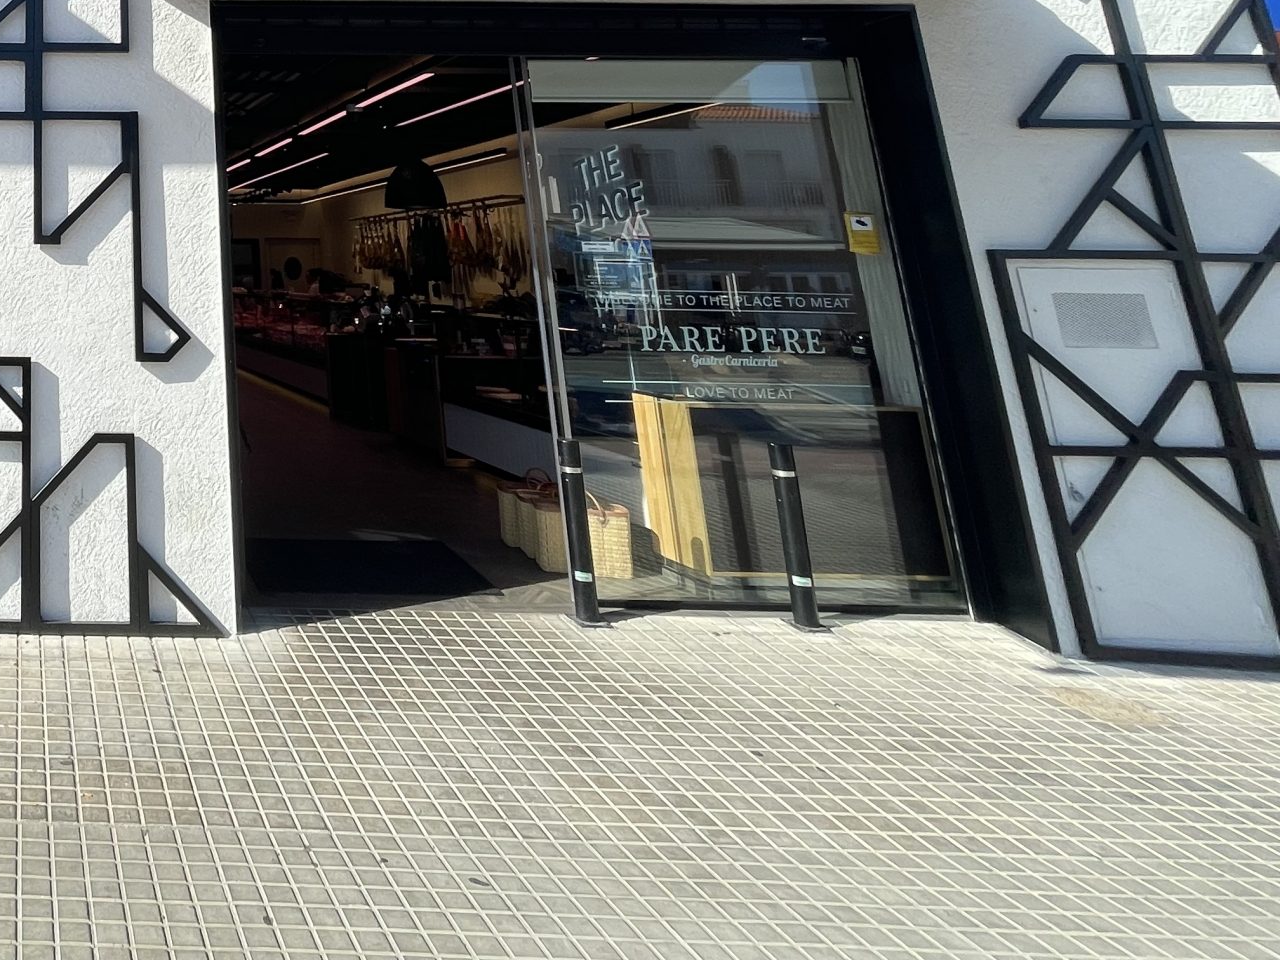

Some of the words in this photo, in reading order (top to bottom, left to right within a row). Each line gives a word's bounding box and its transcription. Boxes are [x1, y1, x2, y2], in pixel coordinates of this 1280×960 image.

[573, 144, 624, 190] THE
[570, 180, 650, 236] PLACE
[677, 294, 697, 307] TO
[700, 295, 729, 307] THE
[735, 296, 780, 308] PLACE
[785, 296, 806, 308] TO
[810, 296, 850, 308] MEAT
[640, 326, 726, 352] PARE
[737, 326, 826, 354] PERE
[685, 386, 726, 398] LOVE
[729, 387, 750, 399] TO
[754, 388, 794, 400] MEAT
